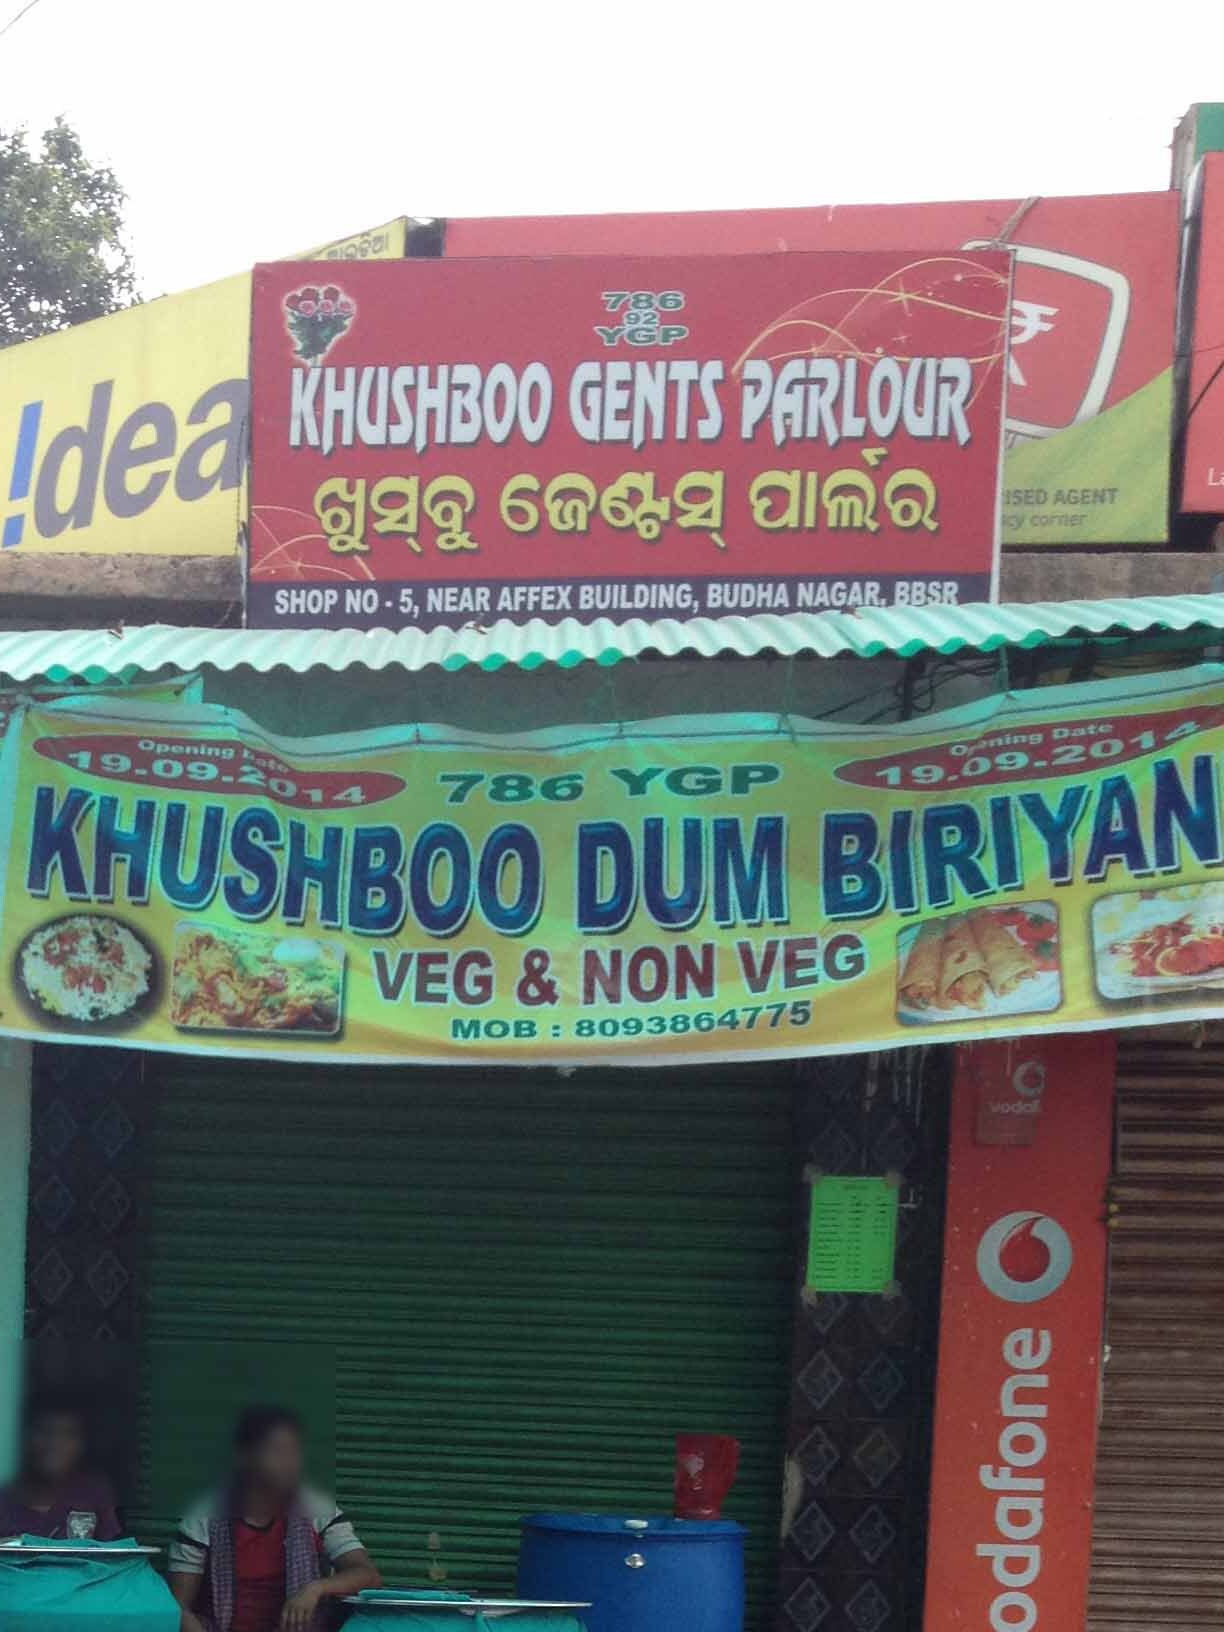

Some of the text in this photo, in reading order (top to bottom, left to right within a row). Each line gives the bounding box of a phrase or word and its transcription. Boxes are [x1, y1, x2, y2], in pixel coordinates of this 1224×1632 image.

[601, 291, 685, 311] 786
[624, 310, 659, 327] 92
[593, 326, 688, 346] YGP
[288, 357, 972, 455] KHUSHBOO GENTS PARLOUR
[1053, 487, 1119, 506] AGENT
[274, 588, 339, 615] SHOP
[345, 588, 378, 615] NO
[399, 588, 420, 618] 5,
[426, 586, 491, 613] NEAR
[496, 585, 573, 612] AFFEX
[578, 583, 700, 614] BUILDING,
[706, 582, 790, 609] BUDHA
[894, 580, 960, 606] BBSR
[137, 738, 235, 760] Opening
[1051, 723, 1114, 740] Date
[875, 720, 1202, 787] 19.09.2014
[67, 750, 367, 804] 19.09.2014
[437, 763, 782, 803] 786 YGP
[25, 752, 1222, 938] KHUSHBOO DUM BIRIYAN
[374, 932, 867, 1007] VEG & NON VEG
[450, 1018, 537, 1040] MOB
[575, 999, 812, 1038] 8093864775
